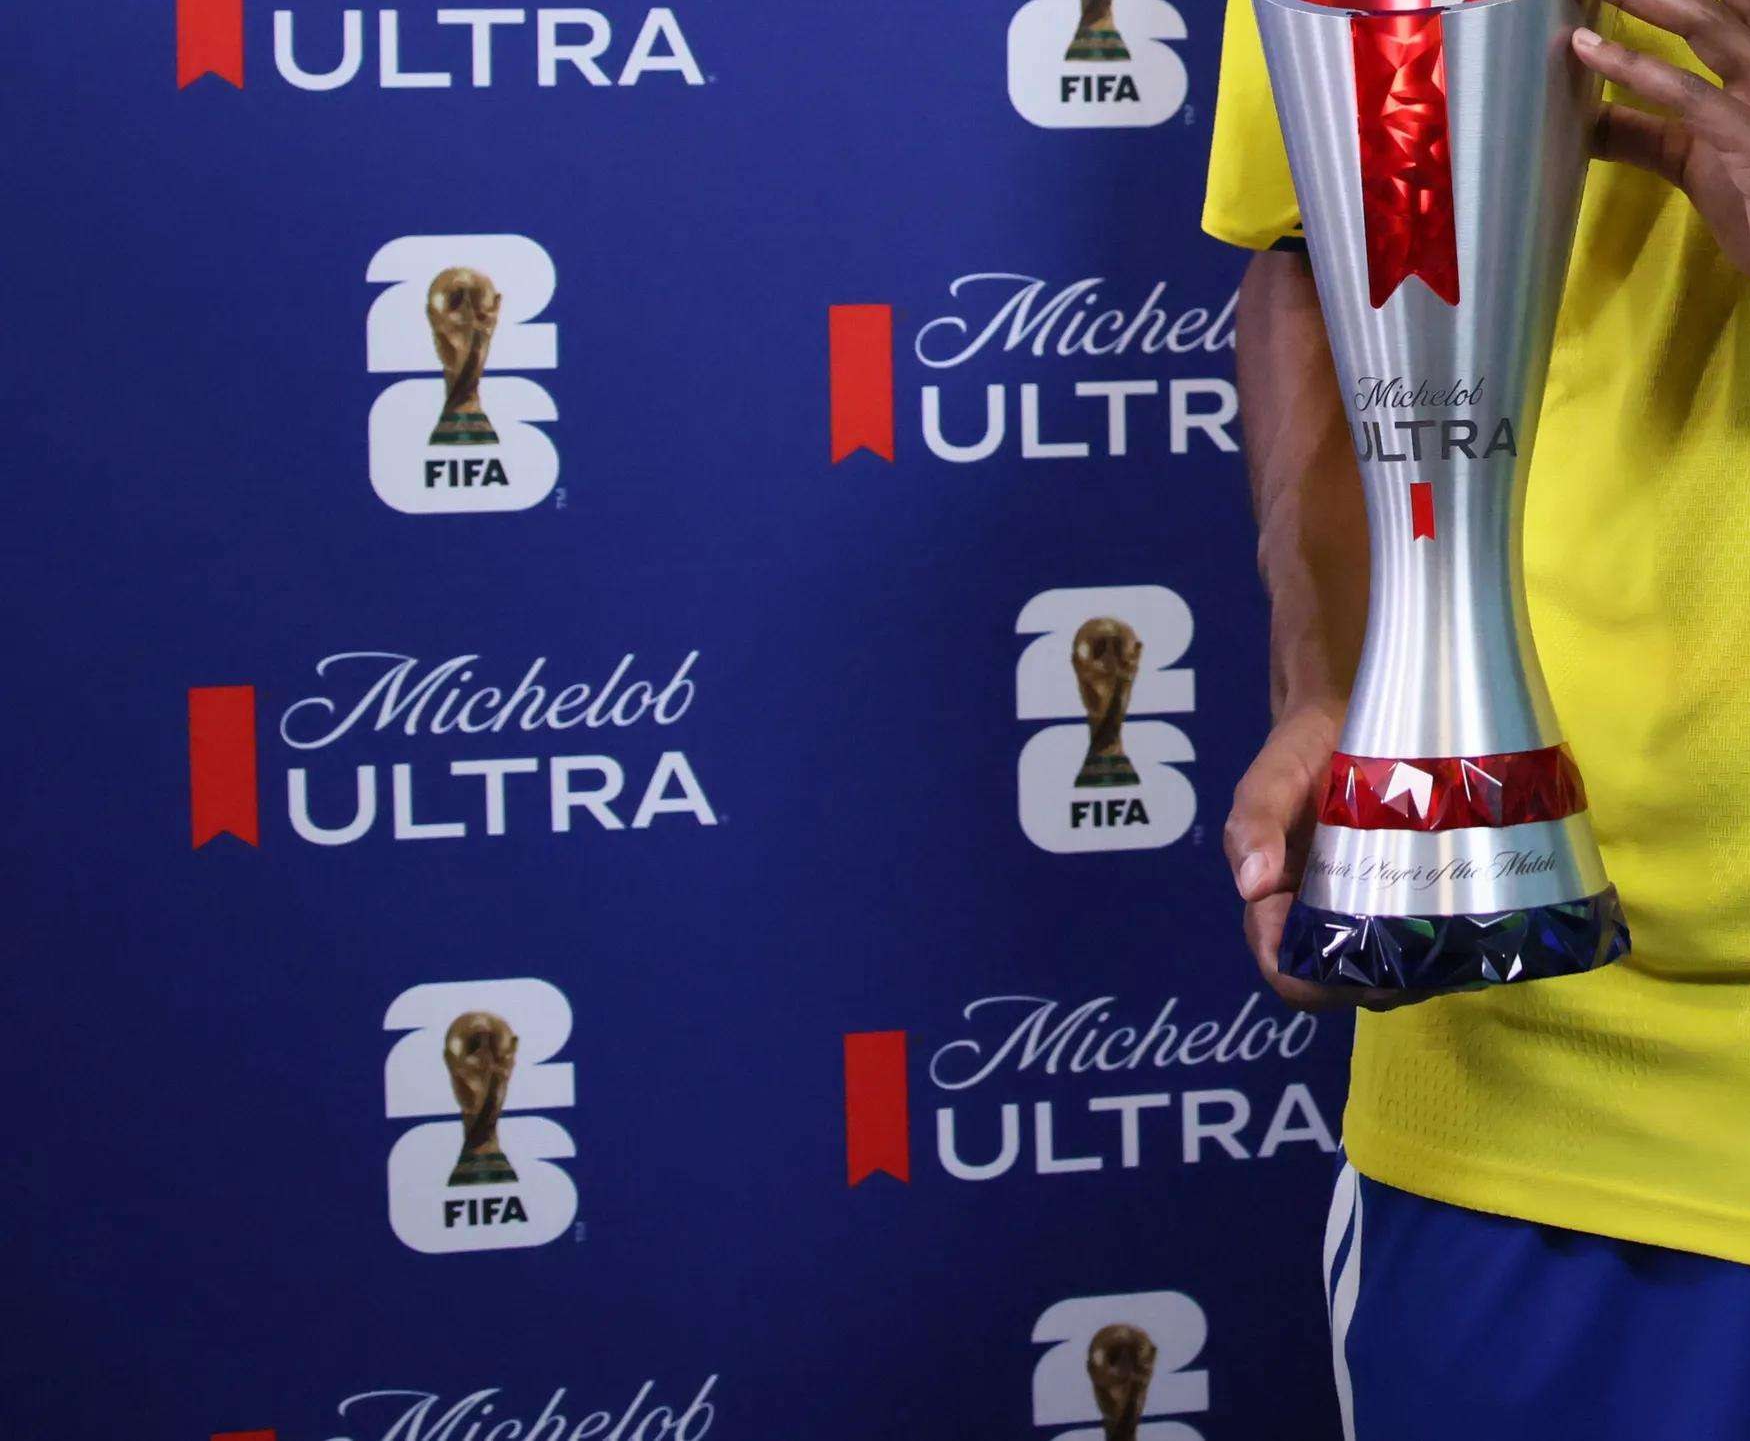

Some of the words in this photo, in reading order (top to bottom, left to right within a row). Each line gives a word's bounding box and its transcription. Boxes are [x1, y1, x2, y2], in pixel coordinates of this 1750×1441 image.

[273, 6, 707, 92] ULTRA
[1061, 74, 1141, 103] FIFA
[914, 272, 1241, 369] Michel
[920, 377, 1241, 464] ULTR
[1354, 375, 1486, 411] Michelob
[424, 458, 510, 488] FIFA
[280, 649, 700, 750] Michelob
[287, 750, 720, 847] ULTRA
[1070, 798, 1150, 829] FIFA
[936, 1082, 1339, 1181] ULTRA
[444, 1195, 529, 1229] FIFA
